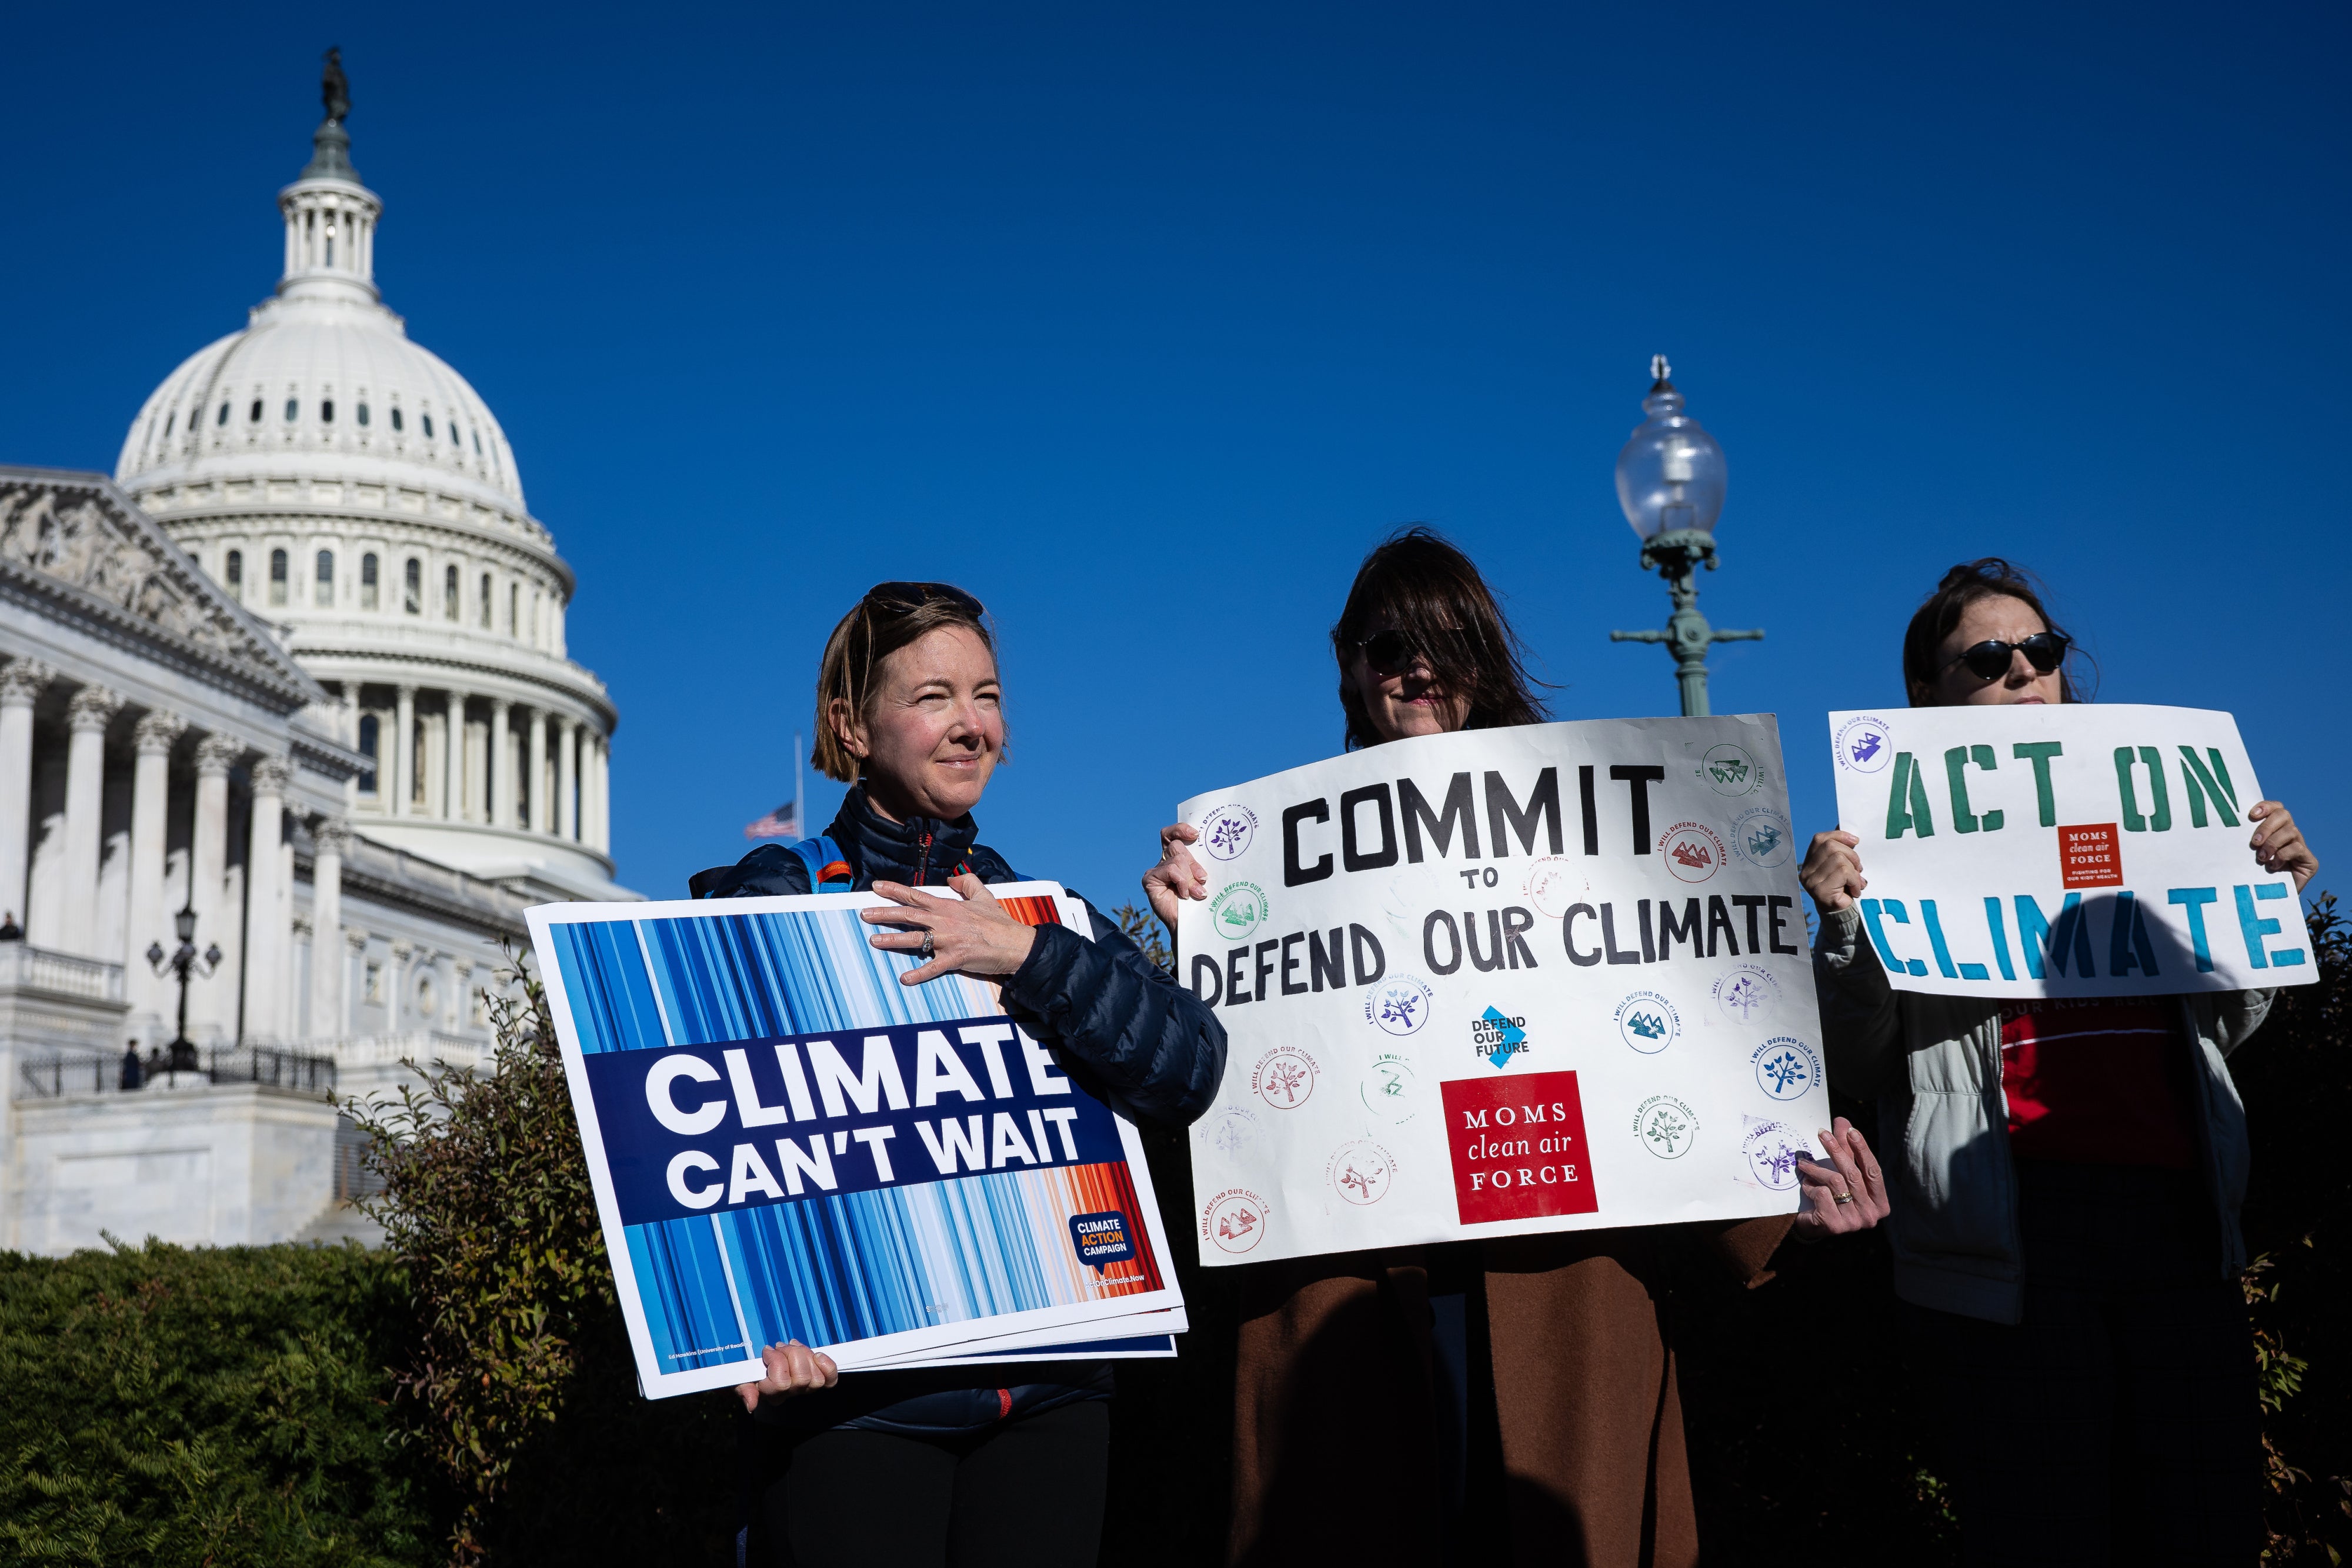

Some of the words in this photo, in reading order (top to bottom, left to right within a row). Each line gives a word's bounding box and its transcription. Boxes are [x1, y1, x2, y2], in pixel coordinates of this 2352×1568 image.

[1863, 716, 1890, 730] CLIMATE
[1835, 725, 1847, 748] DEFEND
[1836, 751, 1846, 766] WILL
[1886, 741, 2063, 839] ACT
[2113, 745, 2240, 832] ON
[1283, 765, 1664, 888] COMMIT
[1730, 814, 1744, 838] DEFEND
[1762, 808, 1787, 822] CLIMAT
[1659, 832, 1670, 846] WILL
[1670, 822, 1697, 832] DEFEND
[1699, 825, 1713, 836] OUR
[1713, 836, 1726, 866] CLIMATE
[2069, 831, 2108, 841] MOMS
[2070, 842, 2093, 853] clean
[2095, 842, 2110, 851] air
[2070, 855, 2111, 864] FORCE
[1460, 867, 1498, 889] TO
[1211, 892, 1224, 908] WILL
[1224, 882, 1248, 893] DEFEND
[1250, 883, 1261, 893] OUR
[1860, 882, 2306, 981] CLIMATE
[1192, 922, 1386, 1009] DEFEND
[1423, 906, 1538, 976] OUR
[1563, 895, 1798, 966] CLIMATE
[1366, 978, 1386, 1000] DEFEND
[1407, 975, 1433, 997] CLIMATE
[1712, 979, 1721, 993] WILL
[1615, 1001, 1626, 1016] WILL
[1626, 991, 1652, 1001] DEFEND
[1655, 994, 1669, 1005] OUR
[1472, 1016, 1526, 1032] DEFEND
[1474, 1031, 1504, 1044] OUR
[1476, 1041, 1529, 1057] FUTURE
[1298, 1050, 1320, 1075] CLIMATE
[1752, 1044, 1767, 1059] WILL
[1767, 1037, 1797, 1045] DEFEND
[1799, 1042, 1812, 1055] OUR
[1811, 1056, 1821, 1087] CLIMATE
[645, 1024, 1070, 1135] CLIMATE
[1463, 1102, 1566, 1129] MOMS
[1638, 1096, 1661, 1113] DEFEND
[1468, 1134, 1530, 1160] clean
[1539, 1131, 1572, 1153] air
[666, 1125, 895, 1209] CAN'T
[915, 1107, 1078, 1174] WAIT
[1470, 1165, 1578, 1190] FORCE
[1205, 1192, 1225, 1215] DEFEND
[1246, 1191, 1270, 1214] CLITE
[1077, 1219, 1120, 1233] CLIMATE
[1082, 1230, 1124, 1246] ACTION
[1084, 1243, 1127, 1256] CAMPAIGN
[1085, 1275, 1145, 1289] ActOnClimate.Now
[698, 1346, 723, 1355] (University
